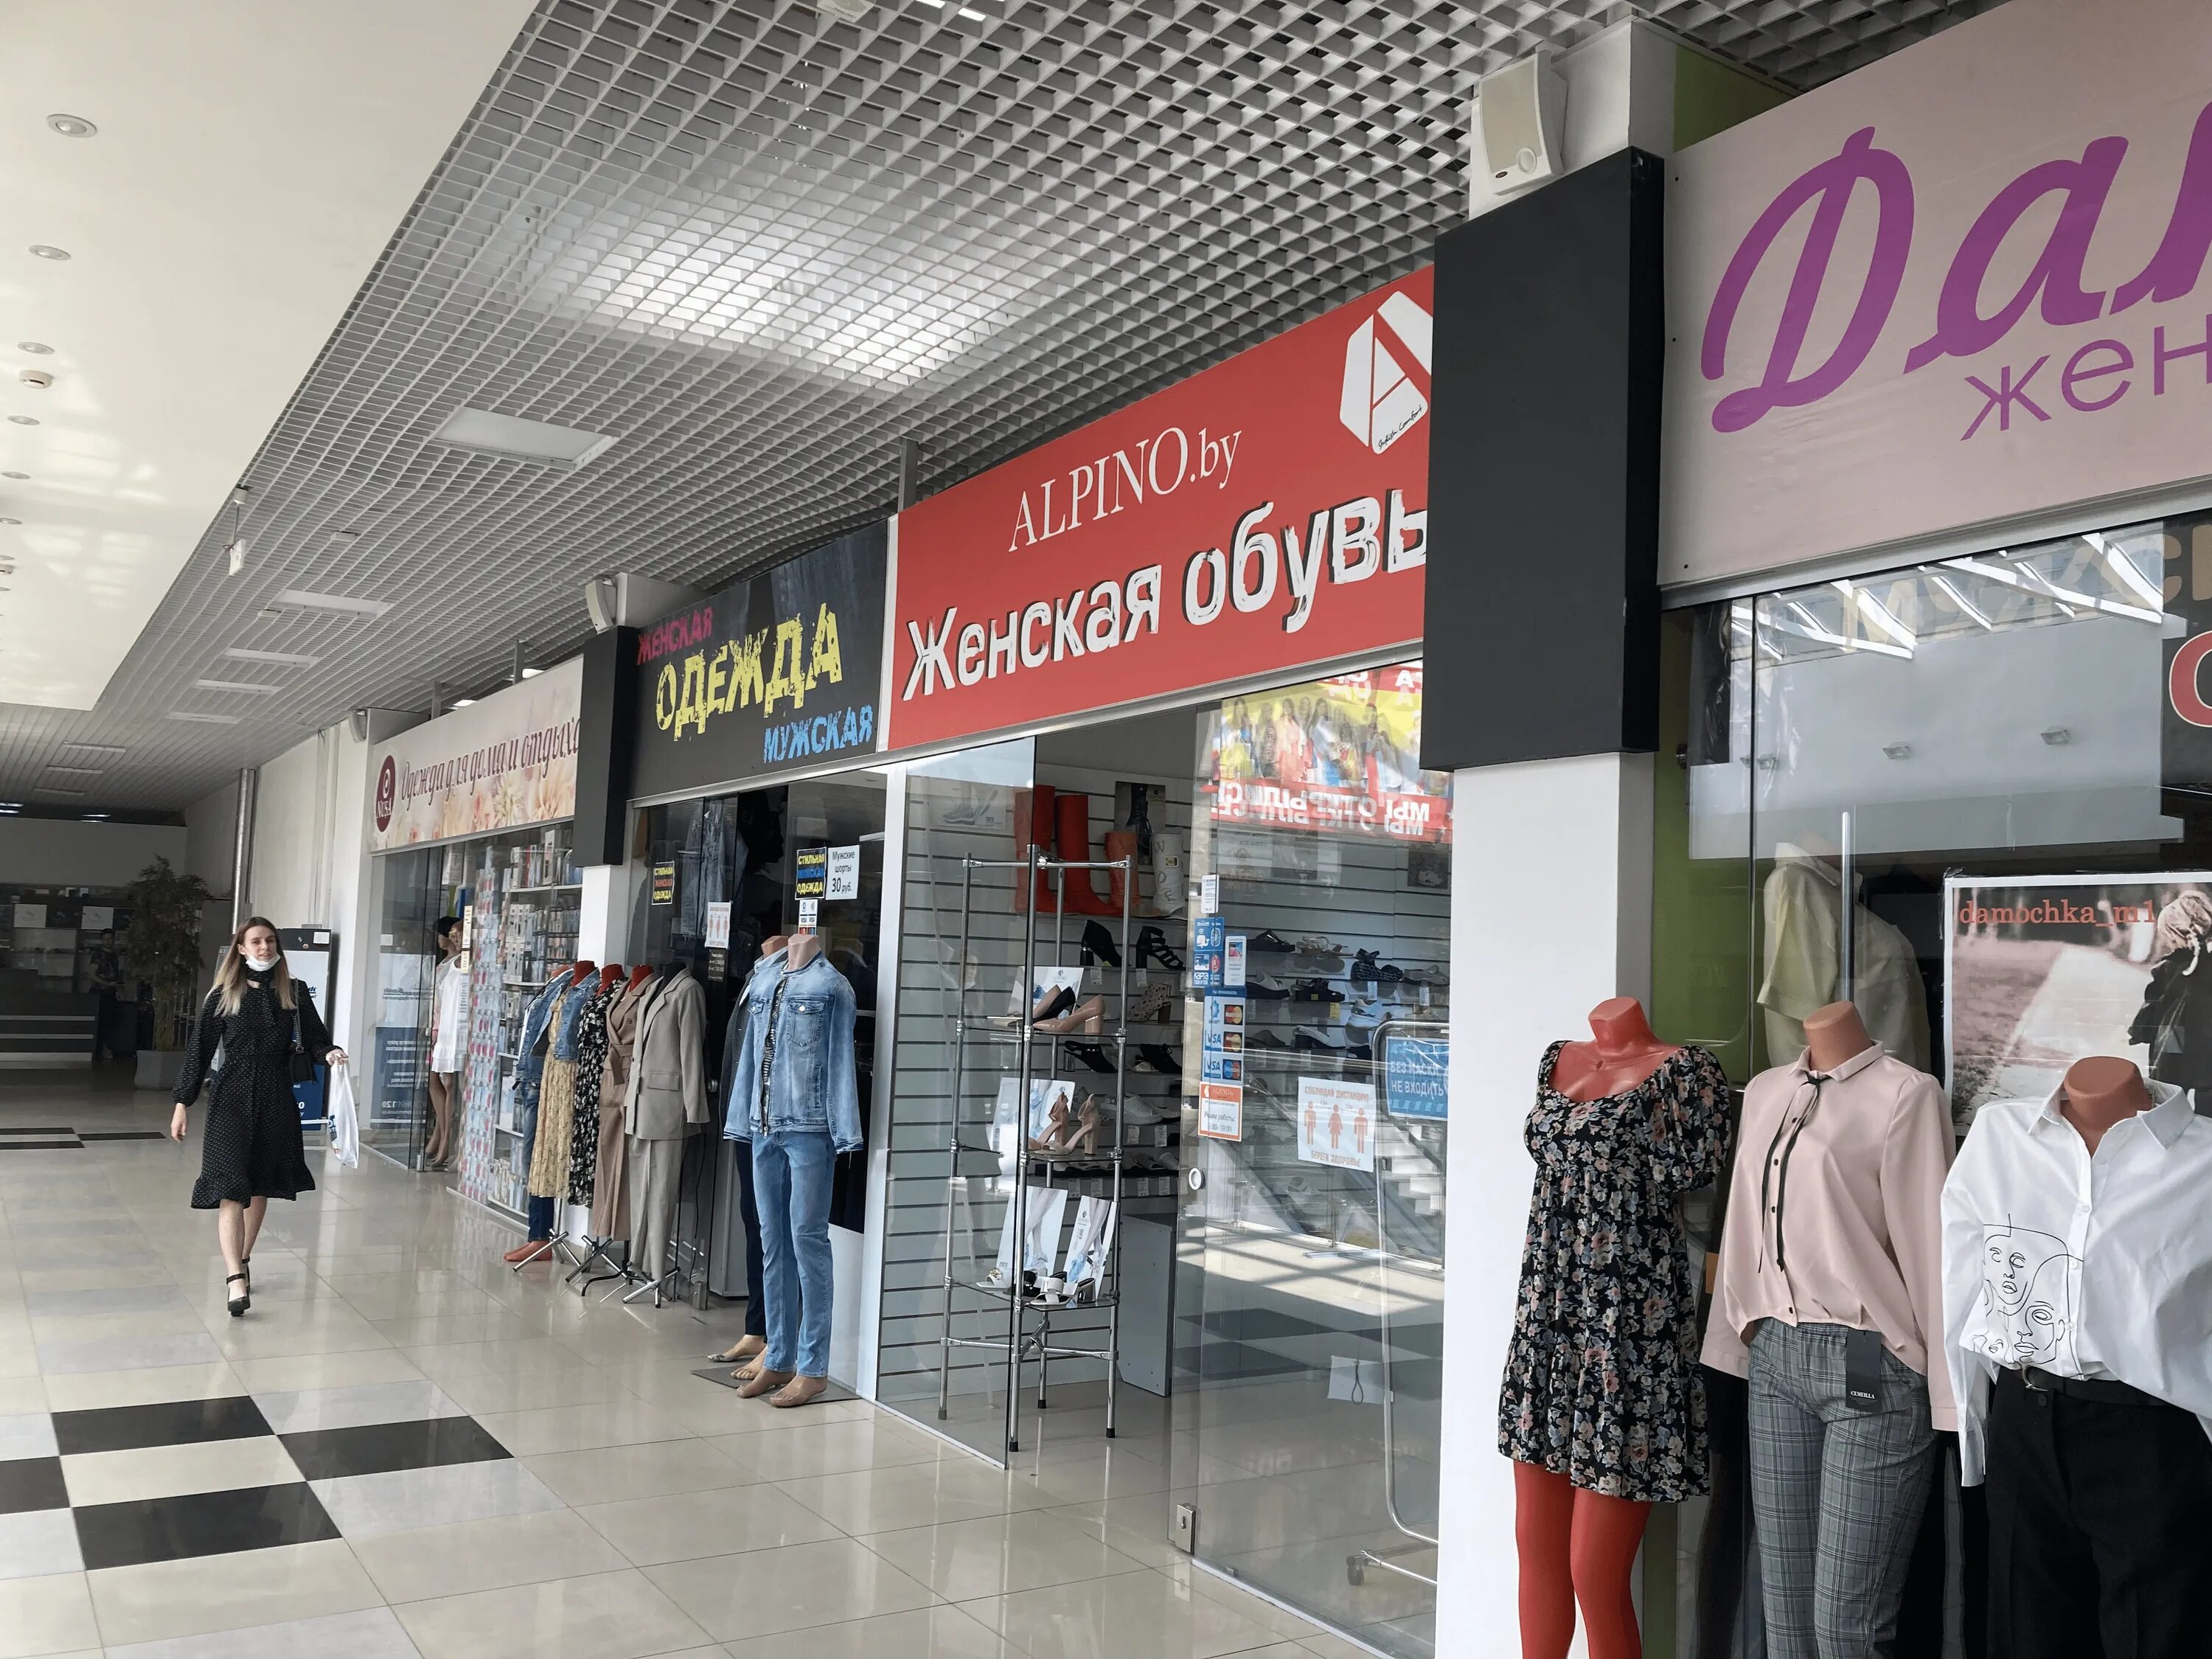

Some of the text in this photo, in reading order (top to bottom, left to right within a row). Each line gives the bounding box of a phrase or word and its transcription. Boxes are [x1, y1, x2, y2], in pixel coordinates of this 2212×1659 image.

[1008, 426, 1242, 552] ALPINO.by
[902, 489, 1427, 702] Женская обувь
[637, 605, 714, 665] ЖЕНСКАЯ
[656, 602, 843, 742] ОДЕЖДА
[763, 704, 873, 764] МУЖСКАЯ
[401, 761, 445, 811] Одежда
[445, 754, 469, 802] для
[470, 742, 507, 796] дома
[509, 739, 519, 771] и
[832, 851, 855, 862] Мужские
[834, 865, 852, 874] шорты
[796, 881, 823, 894] ОДЕЖДА
[832, 877, 852, 894] 30 руб.
[1390, 1060, 1406, 1074] БЕЗ
[1391, 1079, 1444, 1097] НЕ ВХОДИТЬ
[1330, 1154, 1361, 1167] ЗДОРОВЬЕ
